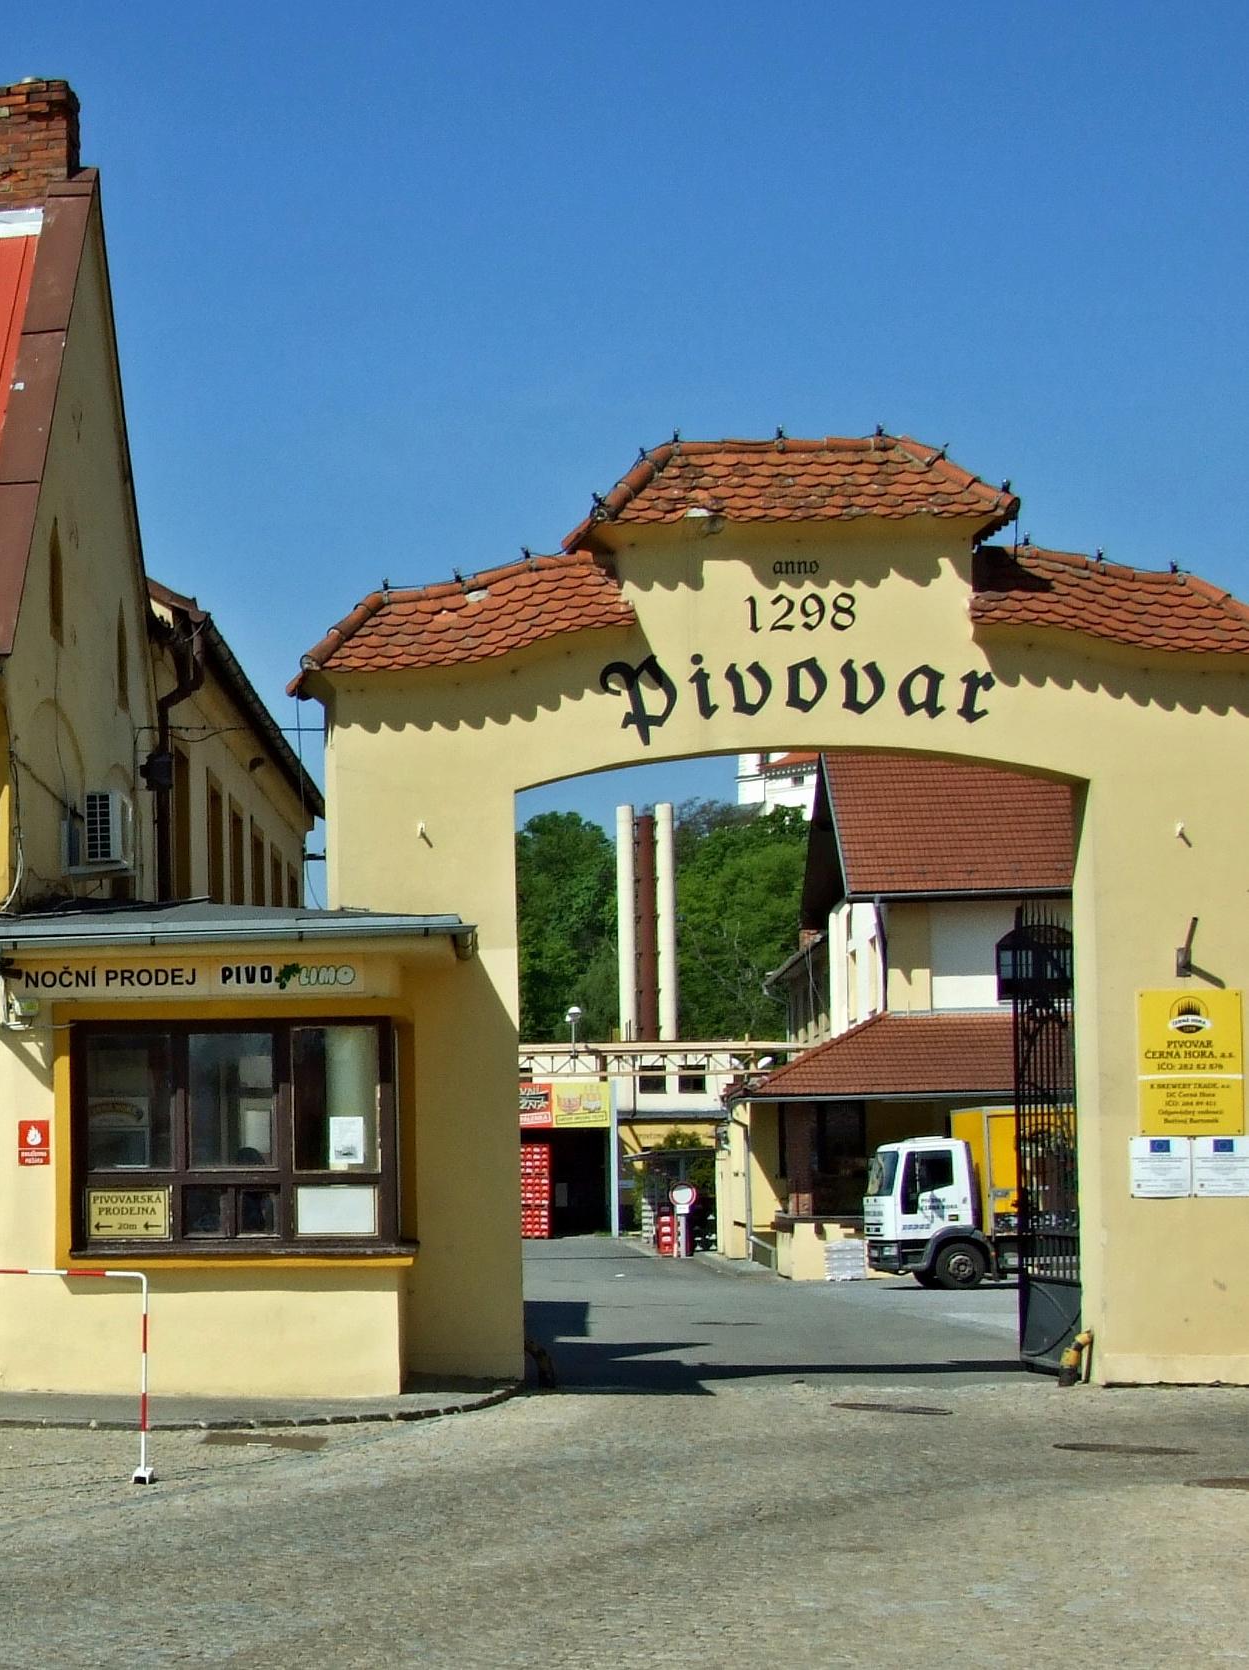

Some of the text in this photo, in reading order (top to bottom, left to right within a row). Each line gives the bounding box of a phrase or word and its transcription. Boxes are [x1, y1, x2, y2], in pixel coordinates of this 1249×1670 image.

[773, 558, 819, 575] anno
[744, 592, 857, 633] 1298
[599, 653, 996, 746] Pivovar
[25, 966, 196, 988] NOČNÍ PRODEJ
[221, 965, 356, 987] PIVO LIMO
[1166, 1040, 1213, 1049] PIVOVAR
[1144, 1049, 1181, 1059] ČERNÁ
[92, 1194, 162, 1205] PIVOVARSKÁ
[98, 1206, 157, 1216] PRODEJNA
[117, 1222, 137, 1230] 20m
